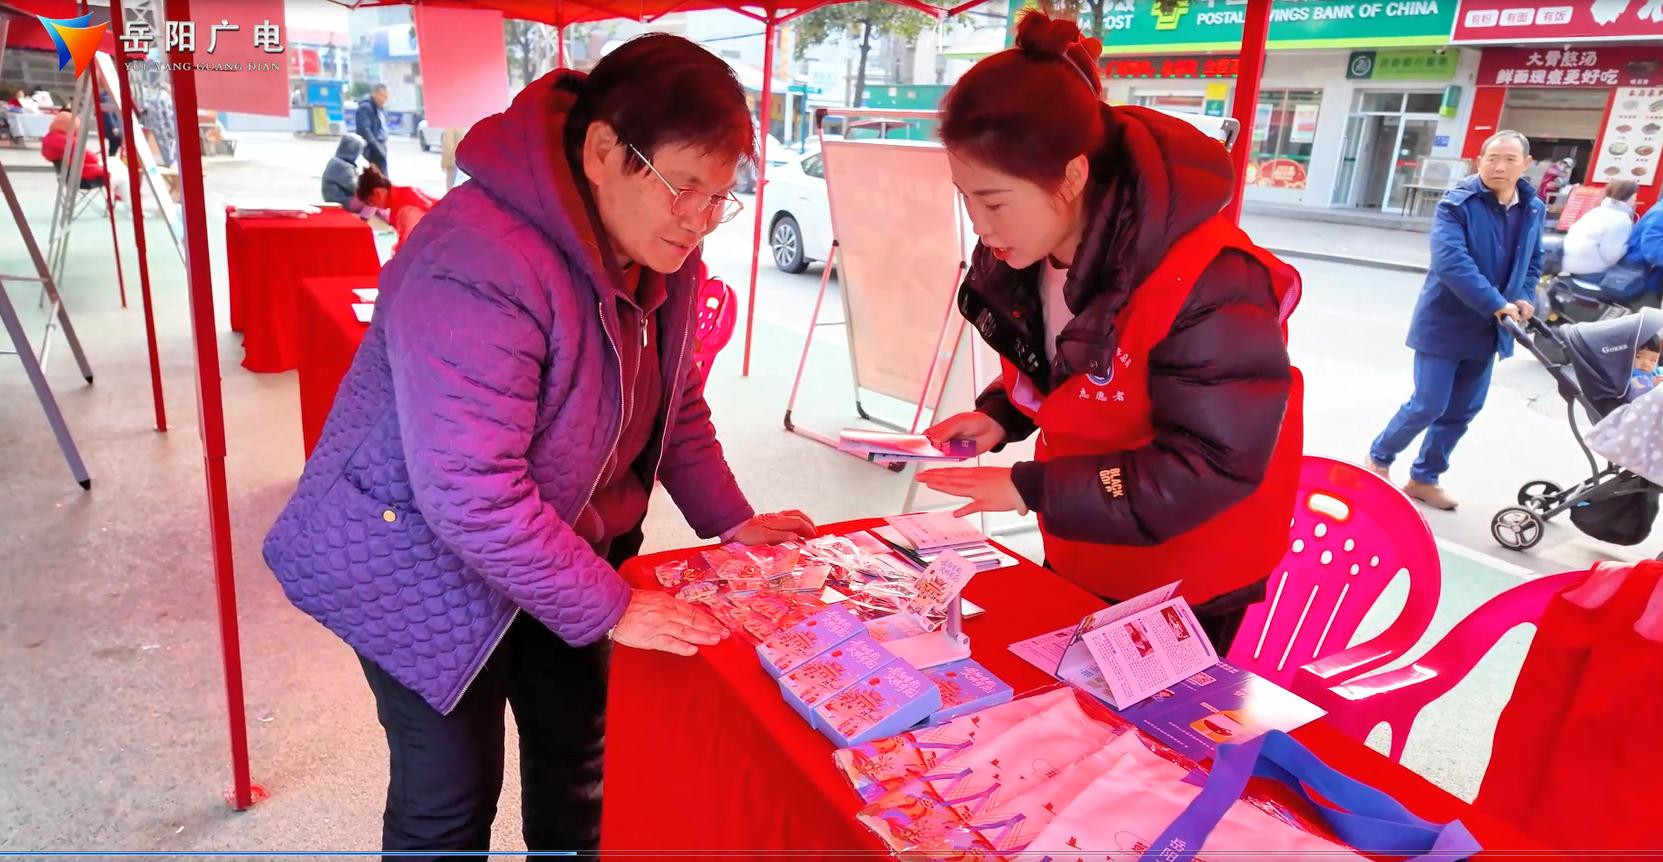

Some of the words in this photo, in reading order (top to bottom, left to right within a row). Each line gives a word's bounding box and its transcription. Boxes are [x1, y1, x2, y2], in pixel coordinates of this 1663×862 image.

[1197, 11, 1245, 25] POSTAL
[1268, 7, 1310, 22] VINGS
[1313, 4, 1355, 20] BANK
[1359, 2, 1383, 18] OF
[1386, 1, 1439, 16] CHINA
[1507, 13, 1528, 23] 有面
[1102, 14, 1134, 30] OST
[1495, 69, 1619, 85] 鲜面现煮更好吃
[1110, 467, 1124, 498] BLACK
